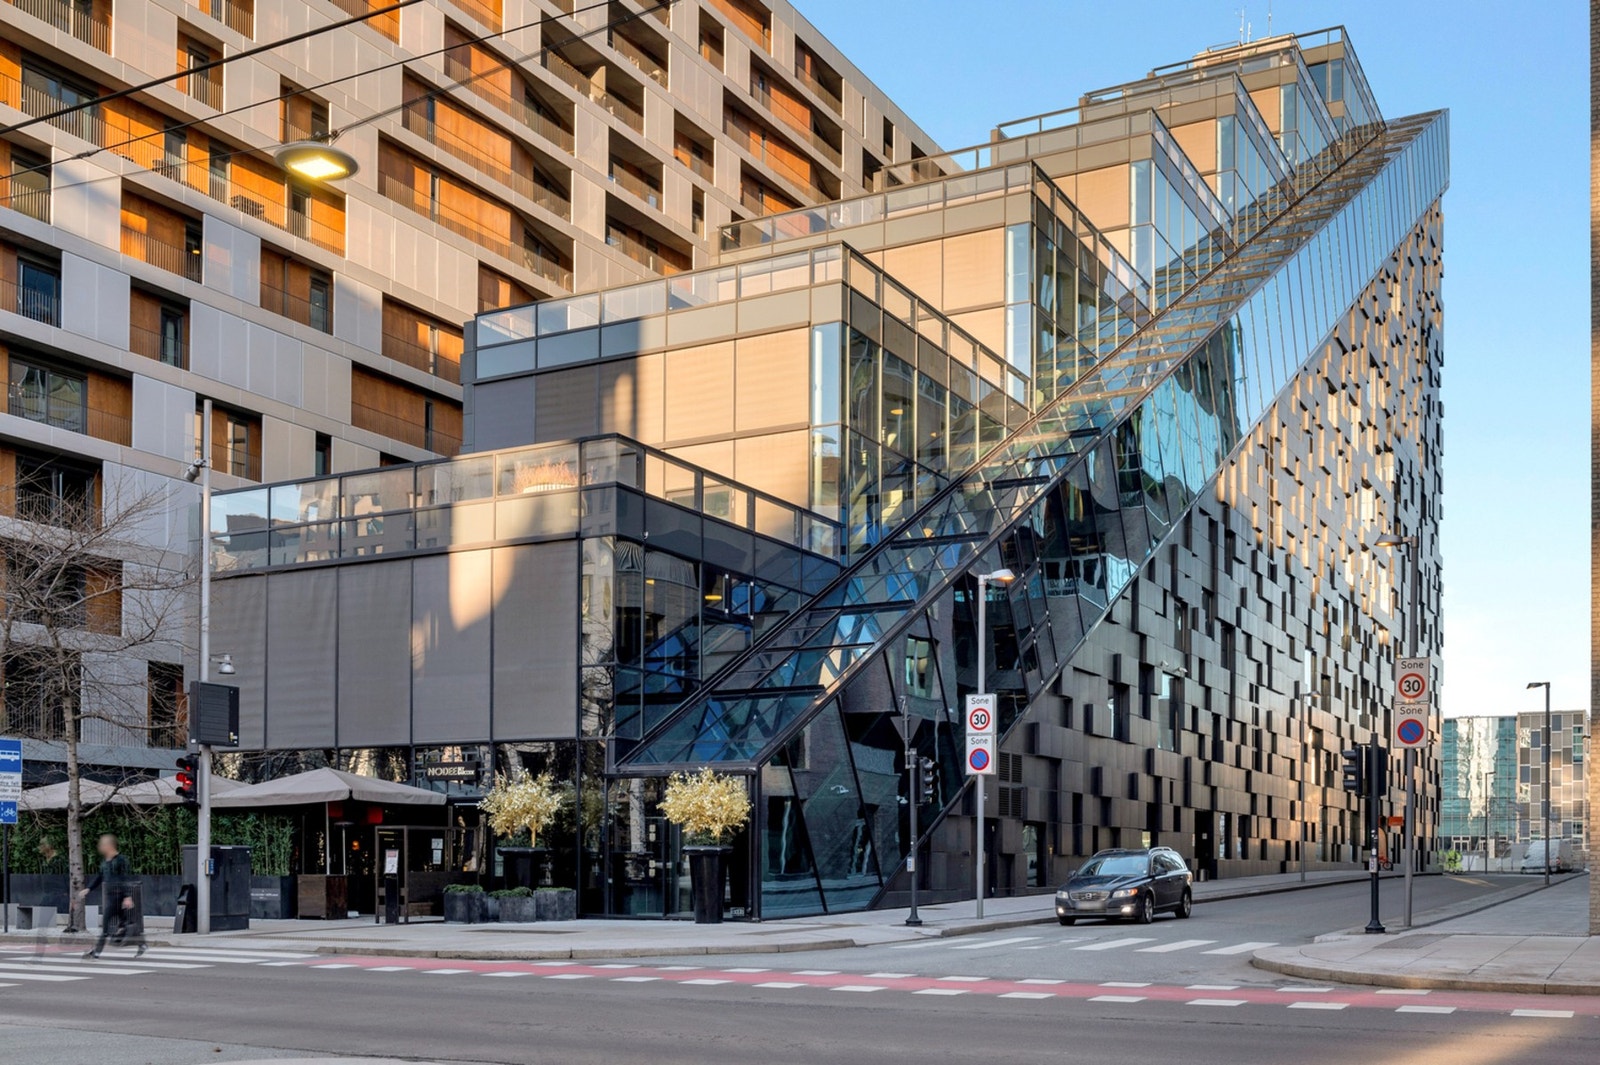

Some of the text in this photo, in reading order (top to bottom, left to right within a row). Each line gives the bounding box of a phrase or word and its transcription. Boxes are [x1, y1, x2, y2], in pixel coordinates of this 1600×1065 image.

[1401, 661, 1424, 669] Sone
[1404, 680, 1421, 692] 30
[971, 697, 990, 705] Sone
[1400, 706, 1423, 715] Sone
[973, 713, 987, 725] 30
[971, 737, 989, 745] Sone
